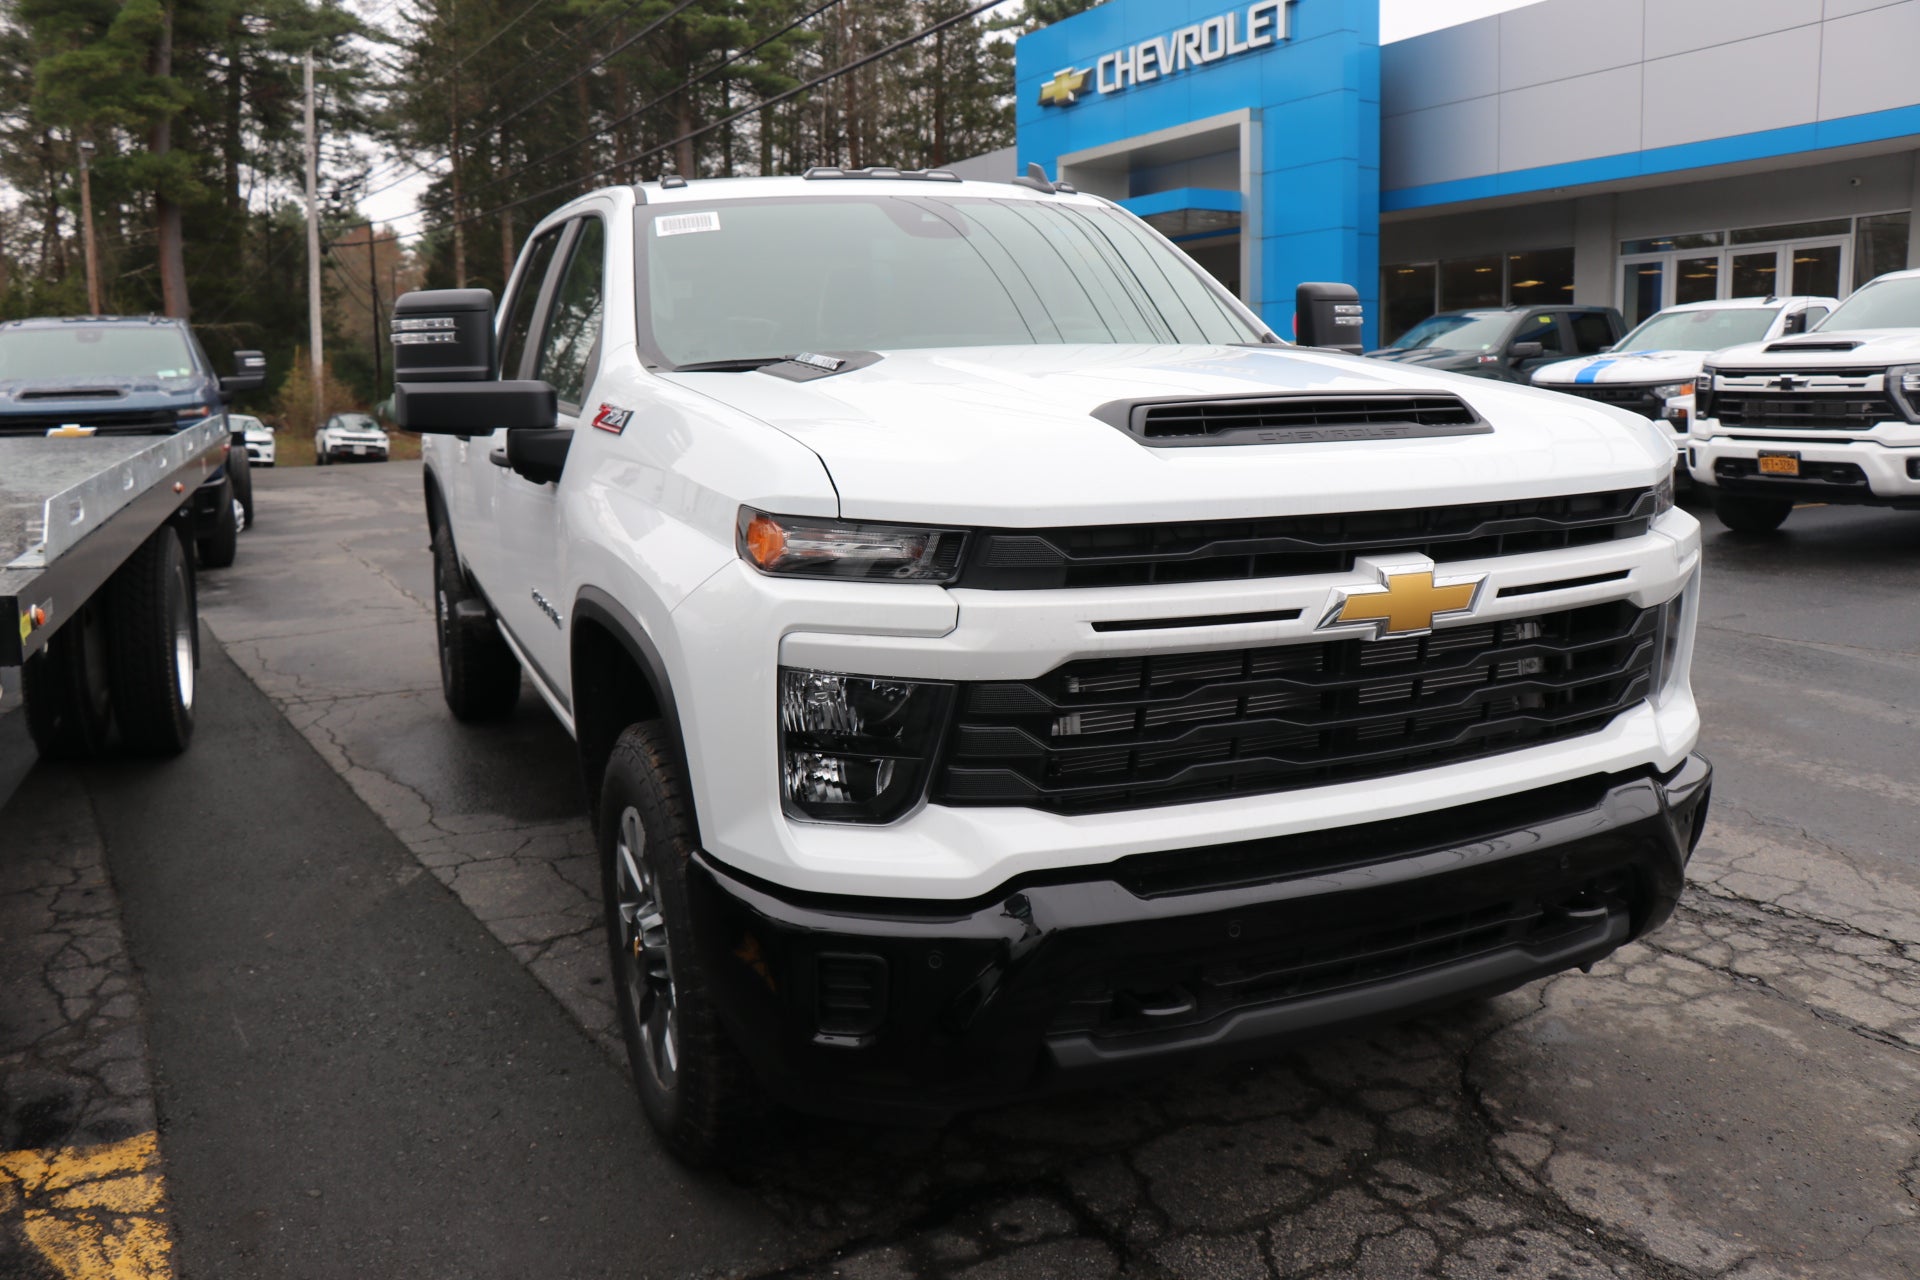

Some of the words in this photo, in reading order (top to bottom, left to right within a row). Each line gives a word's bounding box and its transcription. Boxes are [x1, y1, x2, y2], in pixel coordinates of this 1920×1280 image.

[1097, 0, 1294, 94] CHEVROLET
[592, 402, 634, 435] Z71
[1257, 427, 1409, 442] CHEVROLET
